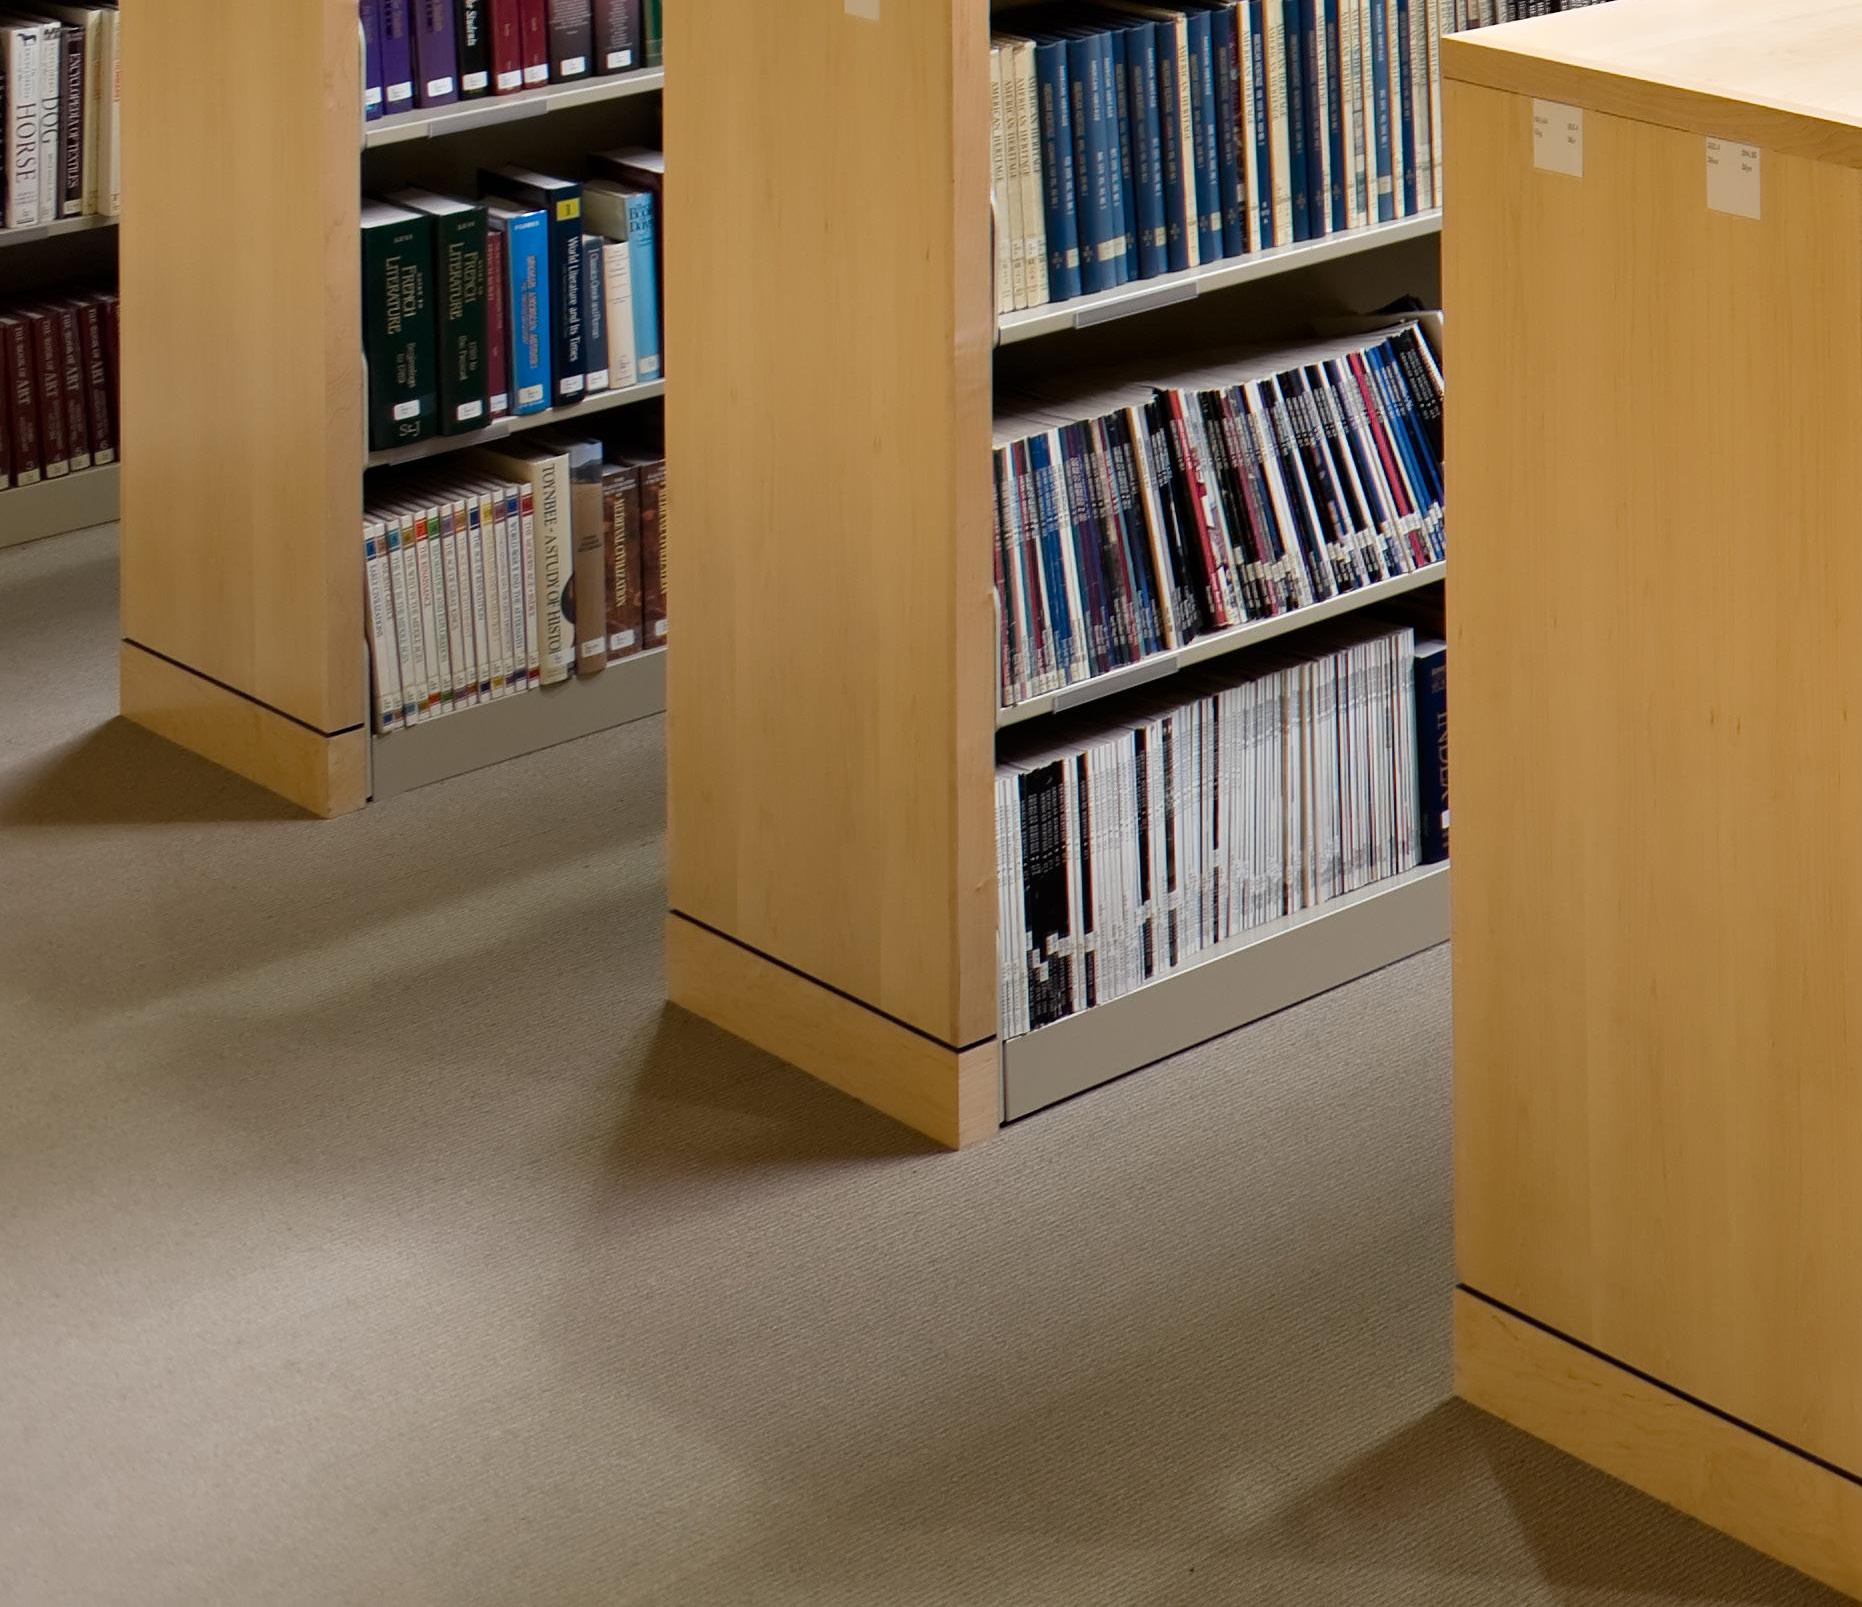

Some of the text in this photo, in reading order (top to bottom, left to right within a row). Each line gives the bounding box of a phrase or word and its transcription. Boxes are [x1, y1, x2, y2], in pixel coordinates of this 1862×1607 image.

[15, 103, 37, 184] HORSE
[40, 96, 60, 145] DOG
[66, 52, 81, 190] ENCYCLOPEDIA OF TEXTILES
[386, 256, 402, 335] LITERATURE
[400, 265, 417, 317] FRENCH
[448, 241, 465, 321] LITERATURE
[463, 251, 478, 303] FRENCH
[568, 236, 581, 362] World Literature and Its Times
[541, 465, 558, 526] TOYNBEE
[544, 543, 560, 590] STUDY
[546, 591, 561, 607] OF
